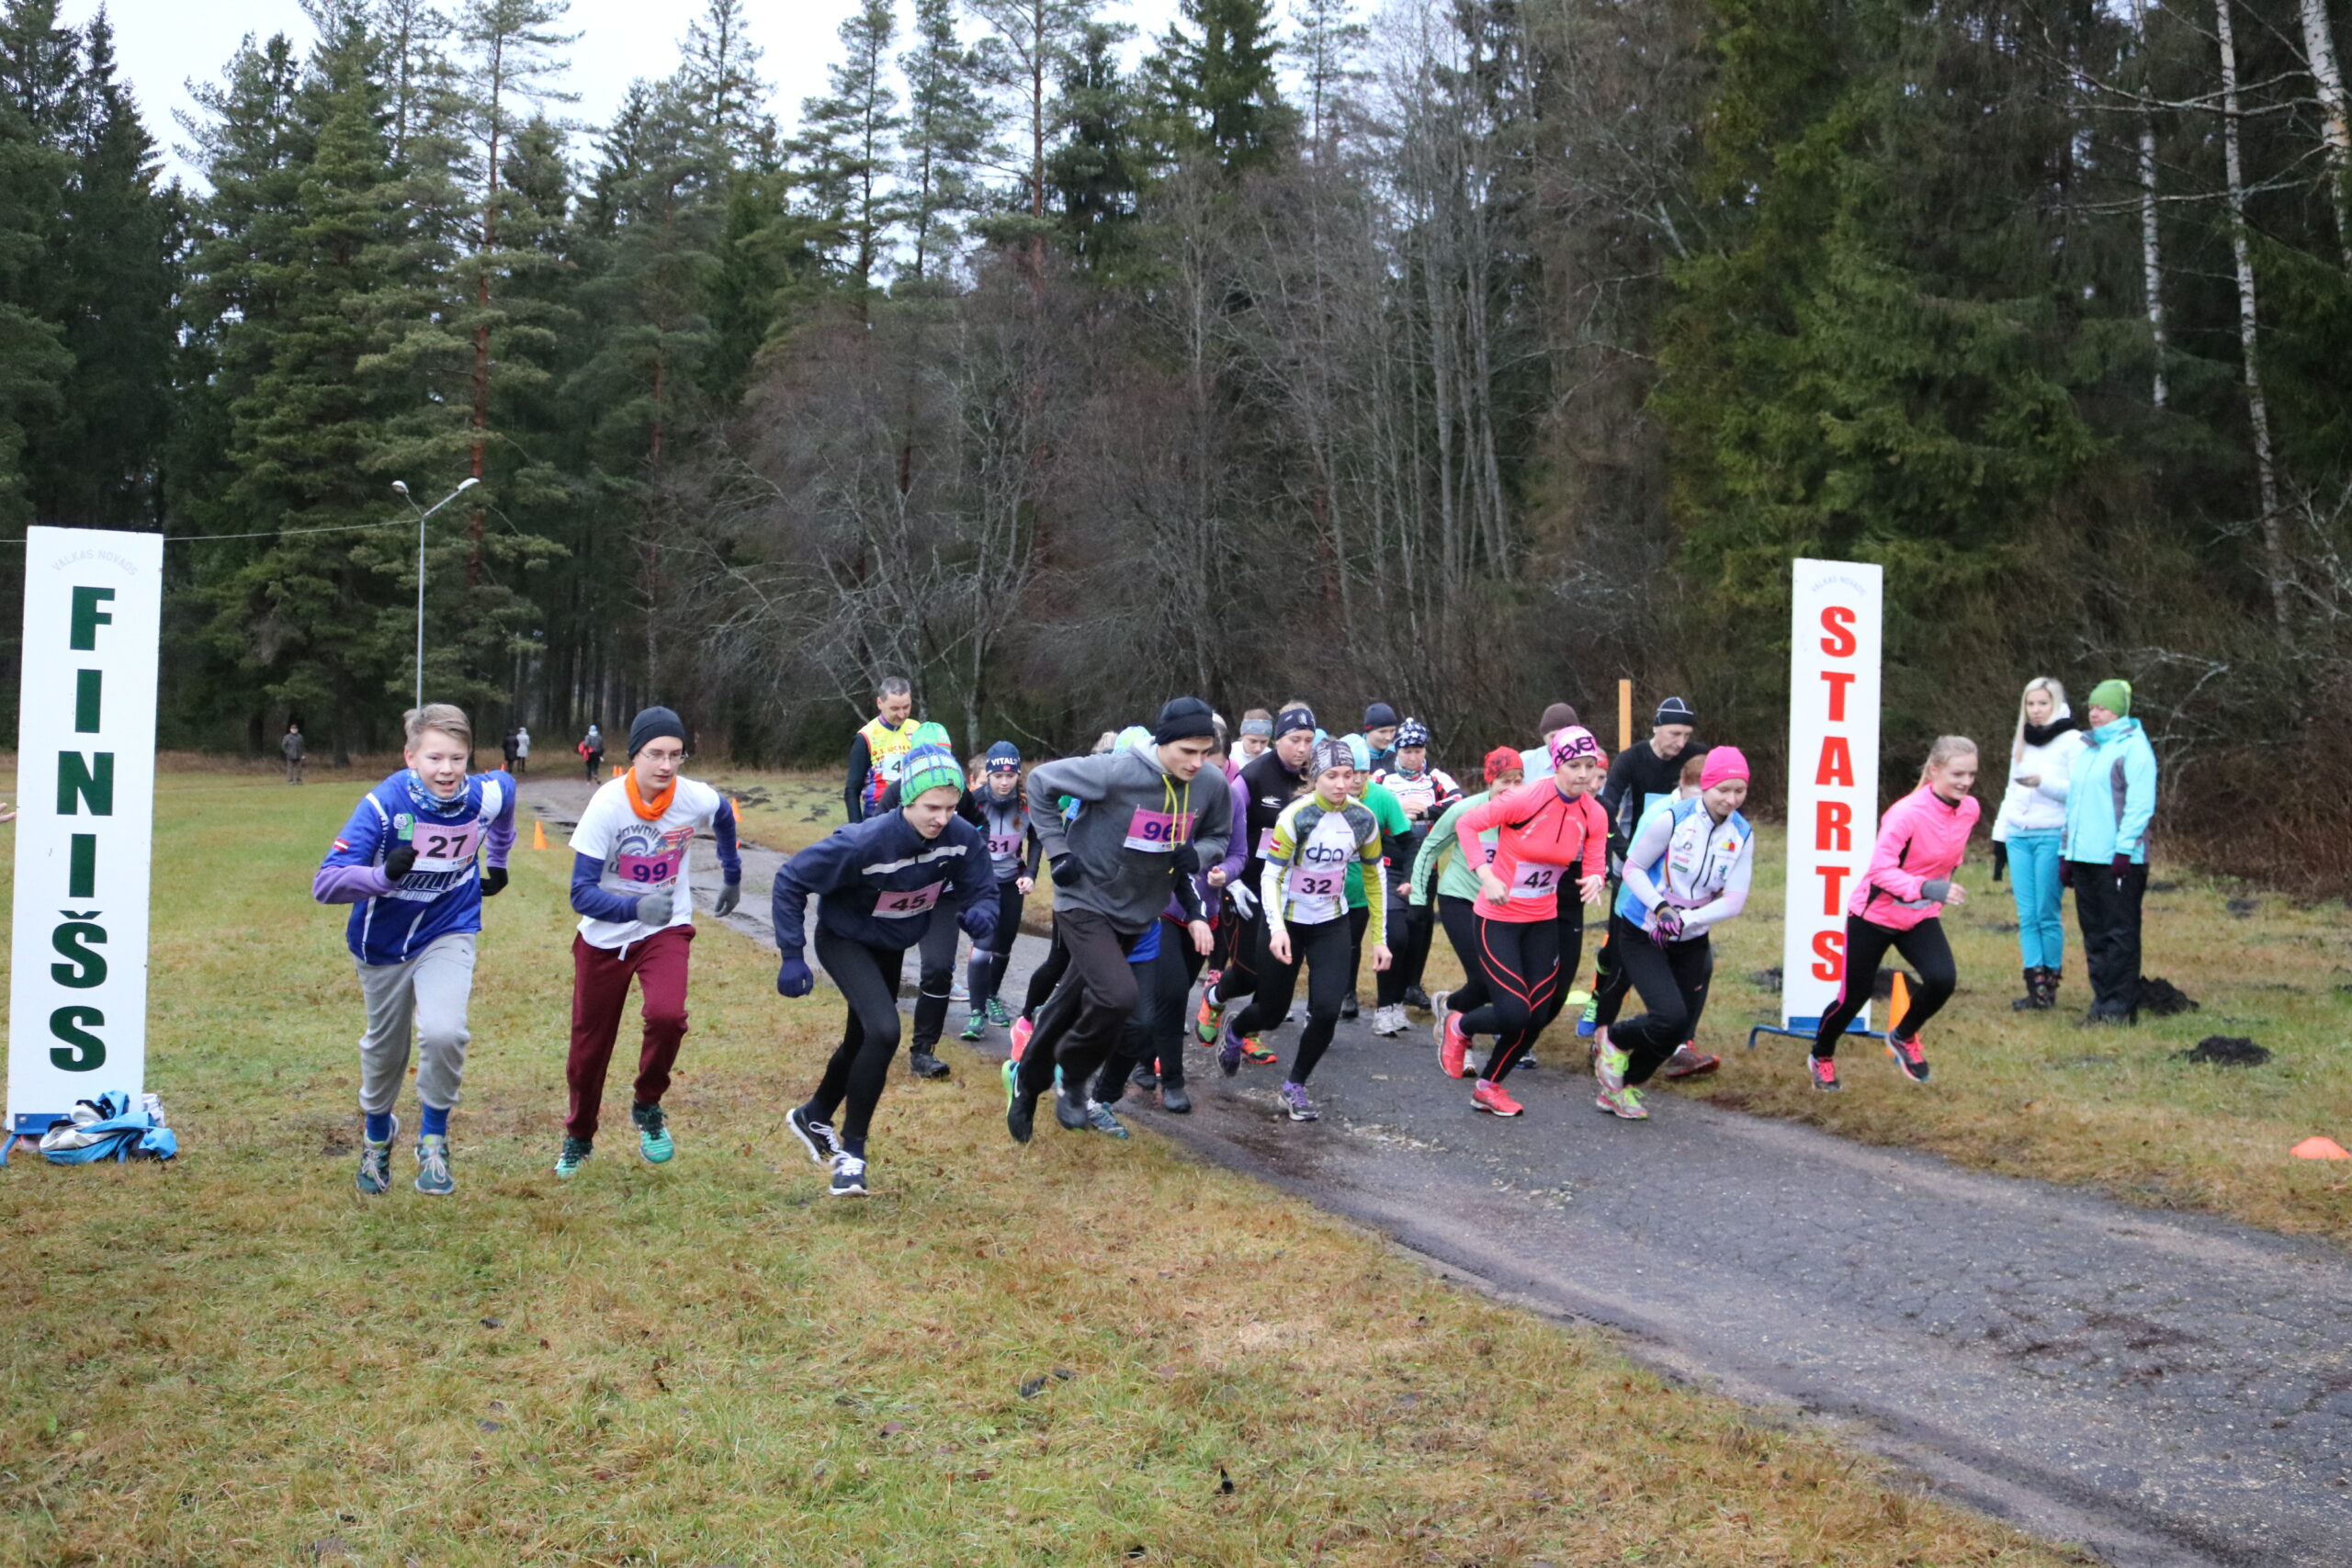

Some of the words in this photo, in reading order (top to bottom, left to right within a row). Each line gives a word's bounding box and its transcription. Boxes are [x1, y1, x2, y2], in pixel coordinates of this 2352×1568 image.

[51, 549, 94, 570] VALKAS
[97, 551, 139, 576] NOVADS
[1812, 606, 1856, 982] STARTS
[50, 585, 115, 1072] FINIŠS
[1143, 821, 1179, 841] 96
[426, 834, 468, 858] 27
[988, 840, 1009, 852] 31
[632, 862, 668, 883] 99
[1524, 870, 1553, 888] 42
[1301, 877, 1332, 894] 32
[889, 893, 927, 910] 45
